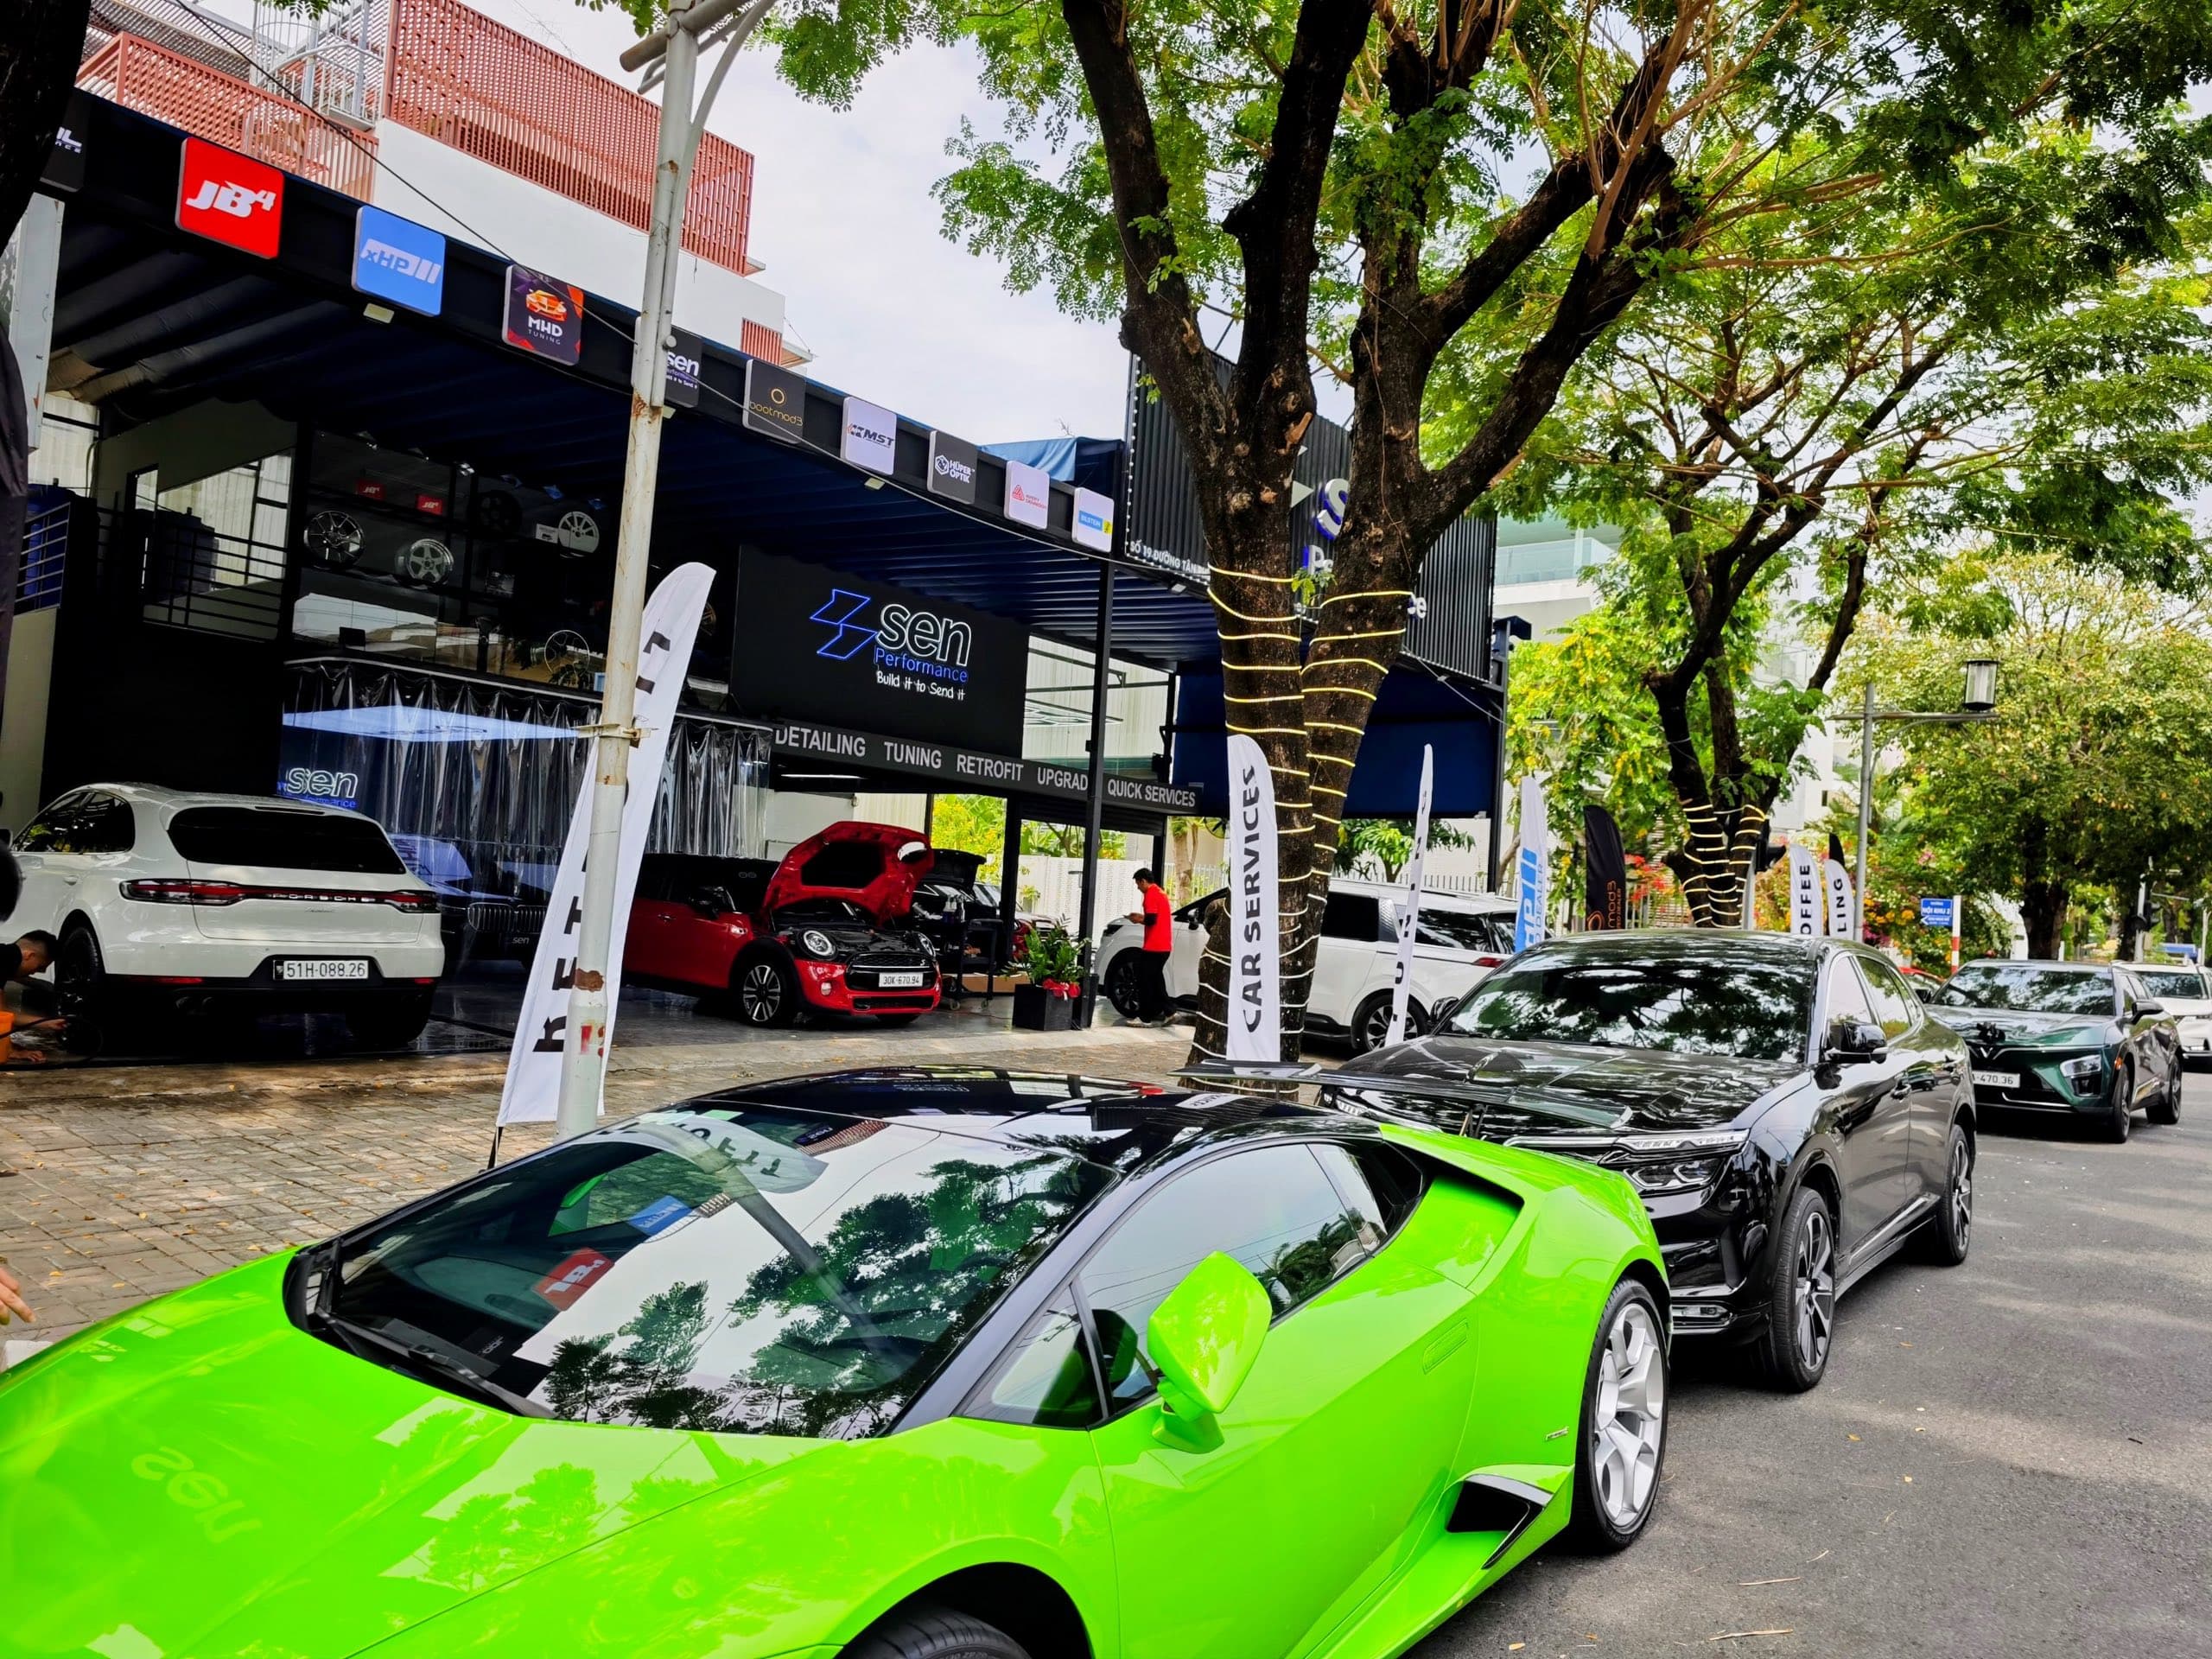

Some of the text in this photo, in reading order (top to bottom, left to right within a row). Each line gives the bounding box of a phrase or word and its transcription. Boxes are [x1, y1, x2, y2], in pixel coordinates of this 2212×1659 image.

[185, 179, 276, 218] JB4
[527, 315, 563, 337] MHD
[528, 328, 562, 345] TUNING
[666, 351, 700, 377] sen
[863, 429, 894, 447] MST
[950, 469, 969, 484] OPTIK
[1129, 539, 1142, 554] SỐ
[875, 603, 972, 667] sen
[874, 646, 969, 683] Performance
[876, 671, 966, 702] Build it to Send it
[285, 766, 359, 799] sen
[774, 725, 1197, 808] DETAILING TUNING RETROFIT UPGRAD QUICK SERVICES
[1241, 764, 1262, 1033] CAR SERVICES
[1607, 880, 1617, 929] mod3
[1799, 865, 1812, 935] OFFEE
[1833, 879, 1847, 933] LING
[286, 963, 365, 978] 51H-088.26
